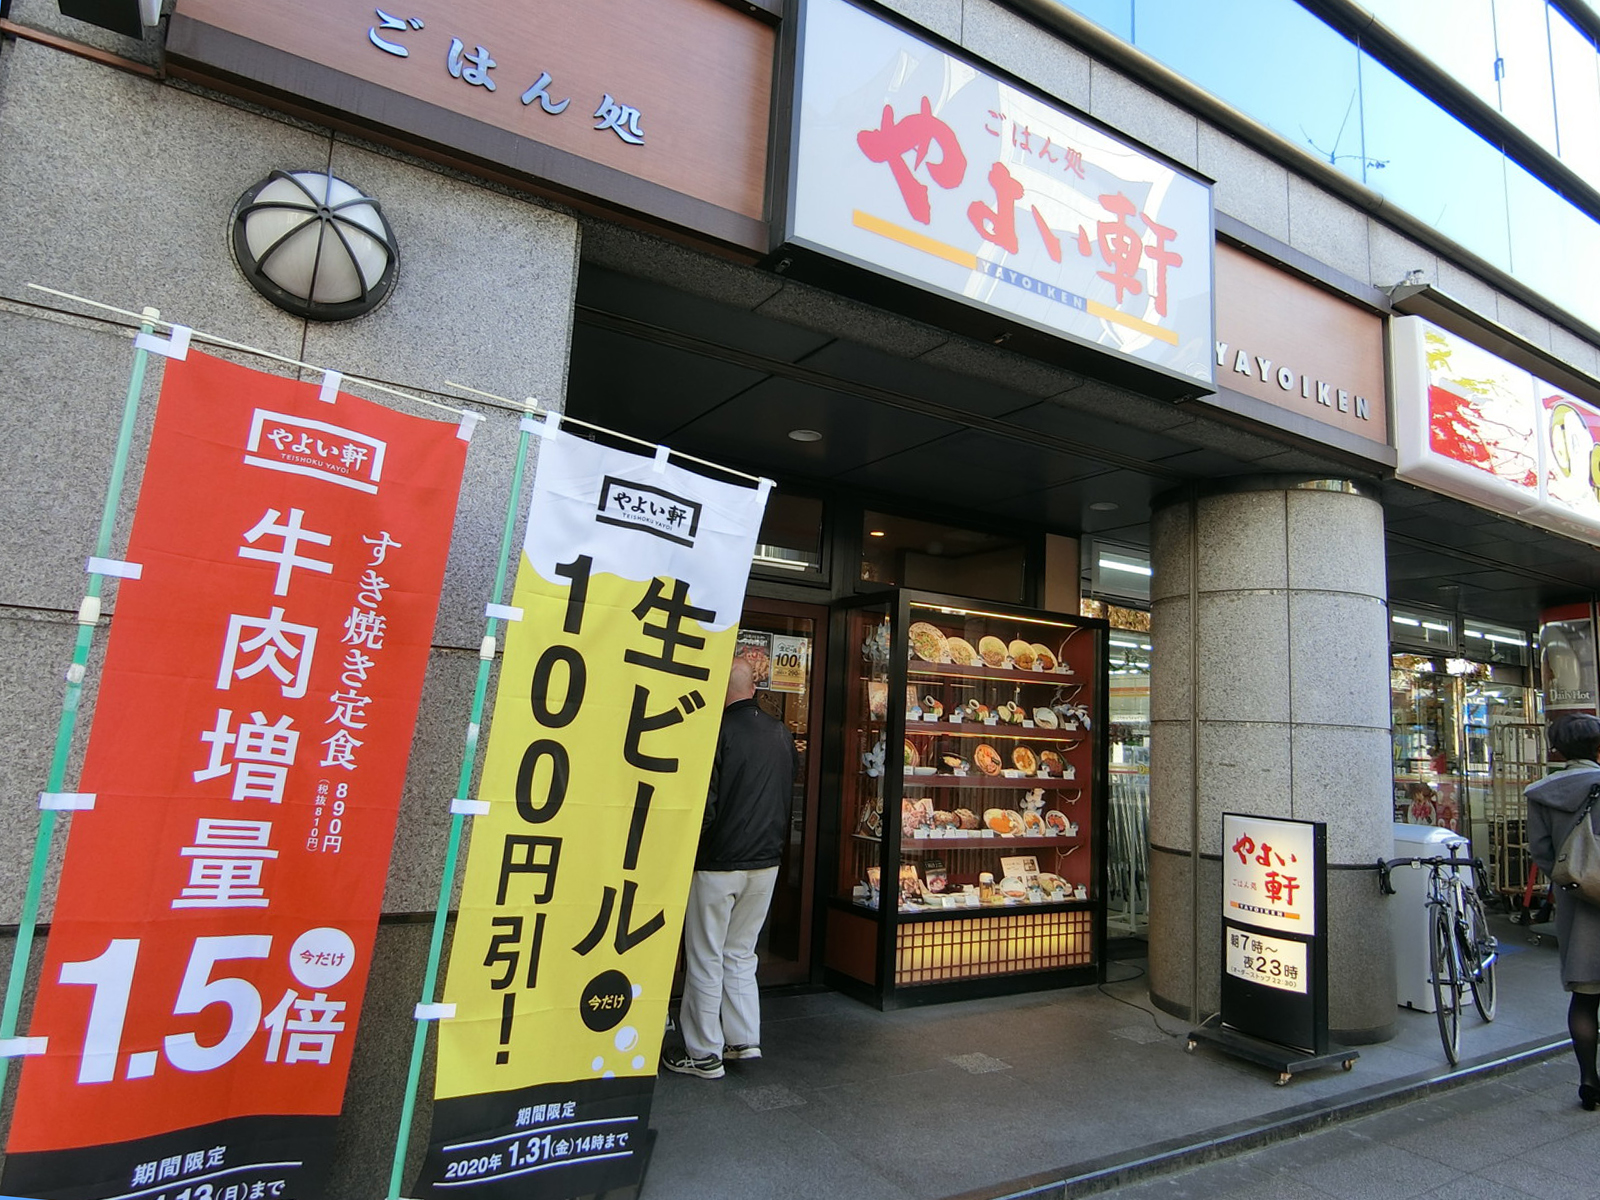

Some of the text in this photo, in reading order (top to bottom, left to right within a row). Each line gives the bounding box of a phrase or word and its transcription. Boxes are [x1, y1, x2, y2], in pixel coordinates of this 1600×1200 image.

[368, 8, 645, 145] ごはん処
[985, 109, 1085, 180] ごはん処
[857, 95, 1183, 318] やよい軒
[981, 260, 1083, 309] YAYOIKEN
[1216, 341, 1371, 420] YAYOIKEN
[267, 428, 369, 471] やよい軒
[280, 452, 350, 475] TEISHOKU YAYOI
[613, 491, 687, 528] やよい軒
[622, 512, 673, 531] TEISHOKU YAYOI
[172, 508, 334, 909] 牛肉増量
[320, 530, 402, 853] すき焼き定食 890円
[1573, 689, 1591, 700] Hot
[571, 576, 717, 956] 生ビール
[1232, 832, 1297, 867] やよい
[1232, 878, 1258, 892] ごはん処
[1264, 870, 1300, 906] 軒
[300, 949, 346, 967] 今だけ
[1243, 955, 1299, 980] 夜23時
[588, 994, 625, 1011] 今だけ
[515, 1101, 577, 1128] 期間限定
[131, 1145, 227, 1187] 期間限定
[444, 1153, 503, 1179] 2020年
